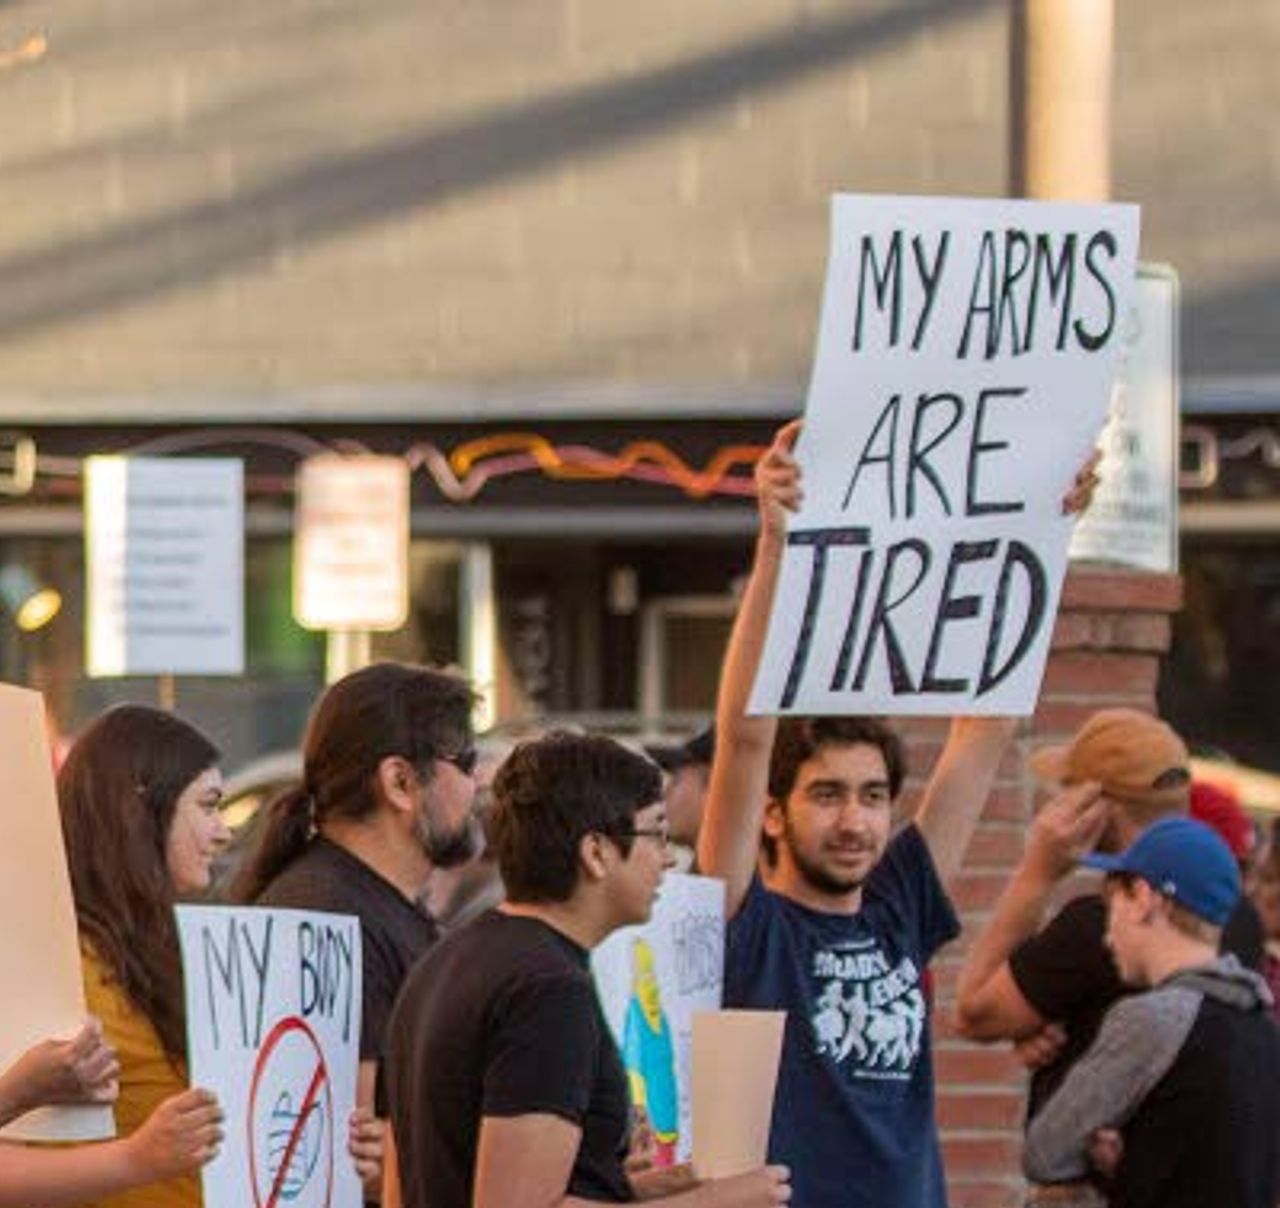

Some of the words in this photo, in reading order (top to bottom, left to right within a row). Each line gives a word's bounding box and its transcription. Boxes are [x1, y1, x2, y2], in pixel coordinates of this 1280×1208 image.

[852, 230, 950, 352] MY
[956, 229, 1117, 361] ARMS
[841, 387, 1028, 519] ARE
[779, 526, 1049, 709] TIRED
[201, 915, 273, 1050] MY
[298, 921, 354, 1043] BODY
